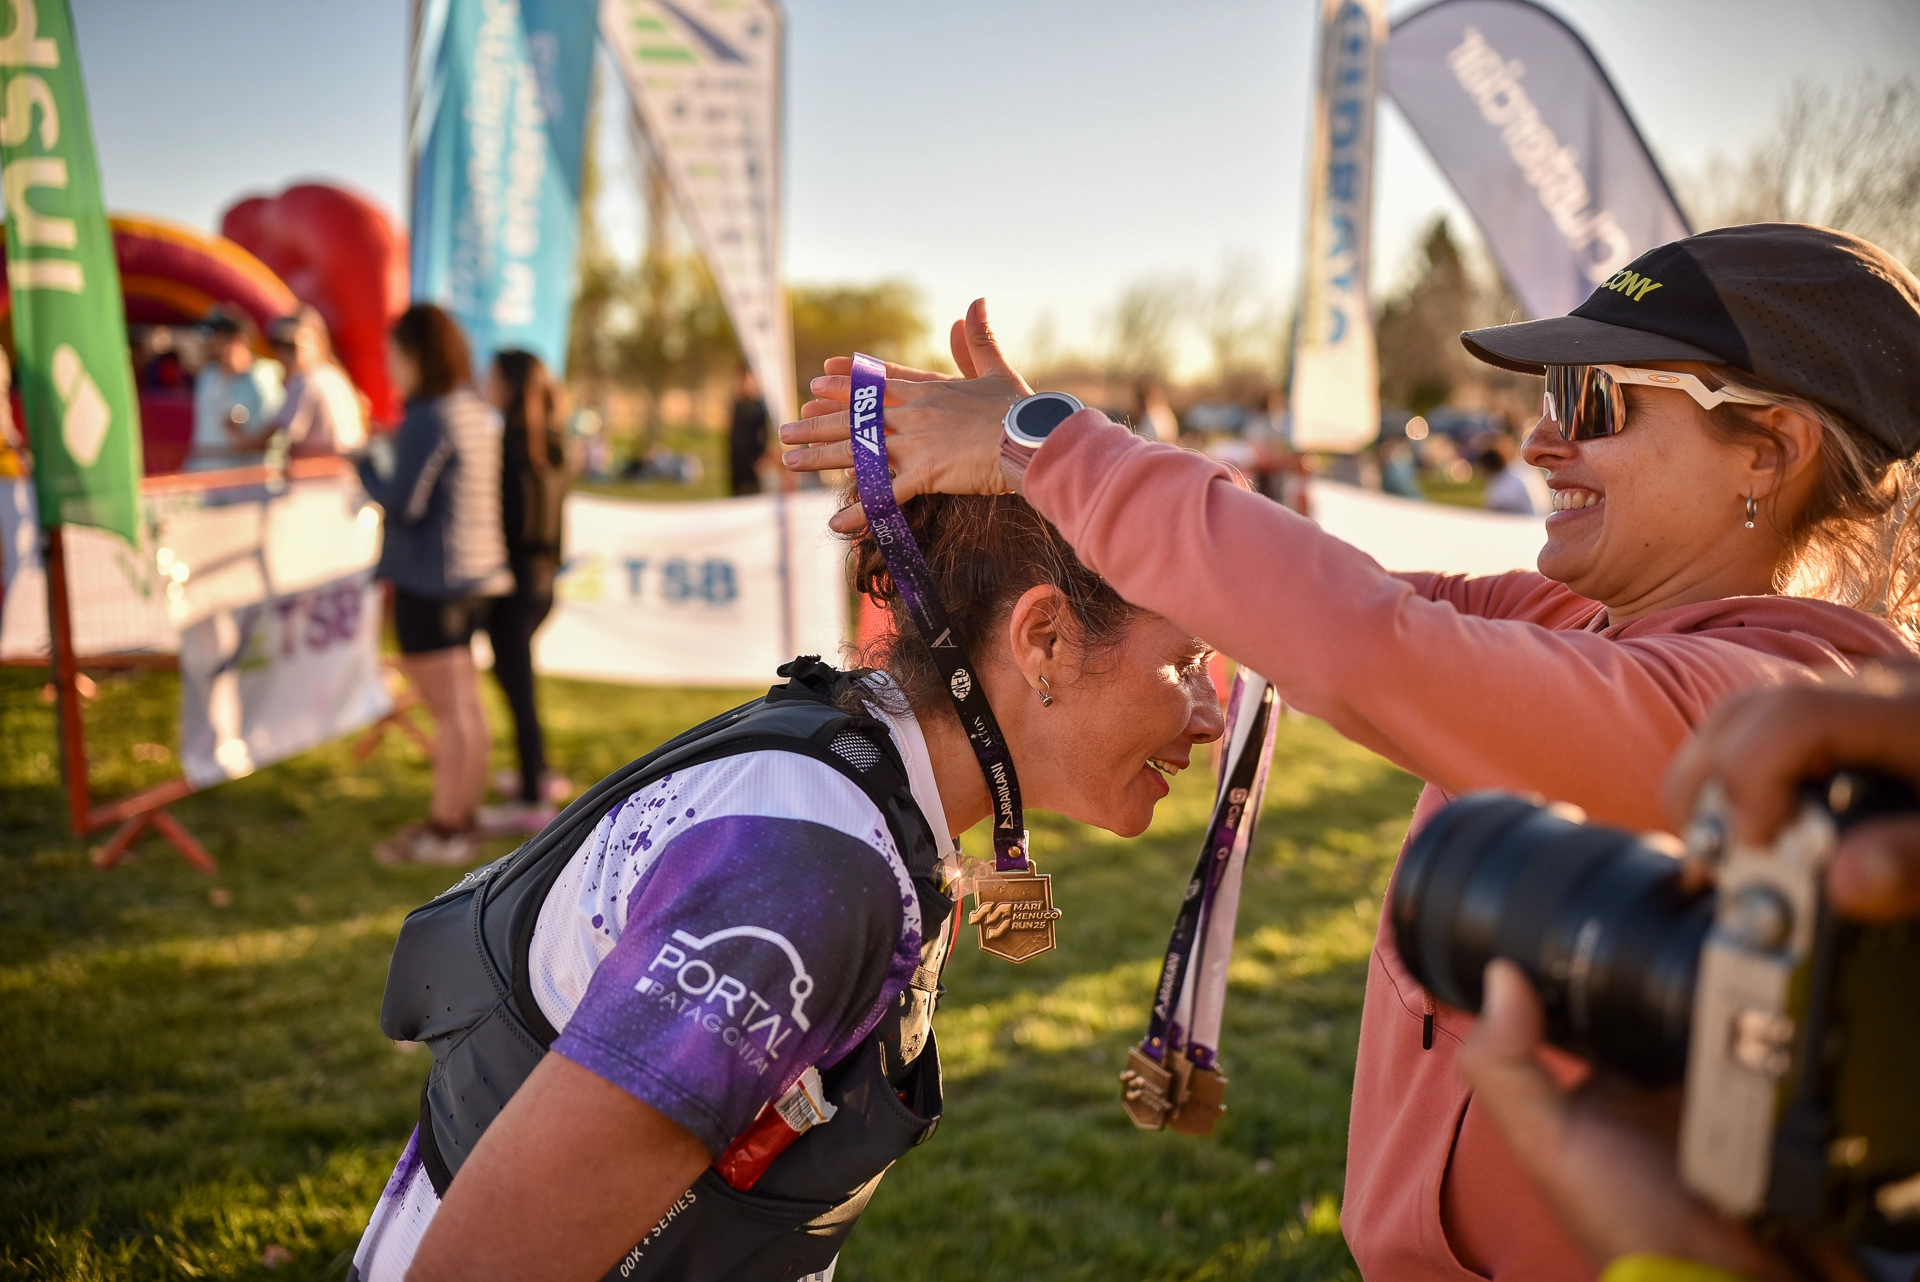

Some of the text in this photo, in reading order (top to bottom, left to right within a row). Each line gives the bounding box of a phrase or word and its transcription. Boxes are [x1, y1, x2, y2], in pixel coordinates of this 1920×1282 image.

[624, 558, 738, 603] TSB
[277, 583, 362, 657] TSB
[1012, 911, 1059, 920] MENUCO
[1013, 902, 1043, 911] MARI
[648, 943, 793, 1060] PORTAL
[647, 980, 766, 1075] PATAGONIA
[651, 1189, 697, 1237] SERIES
